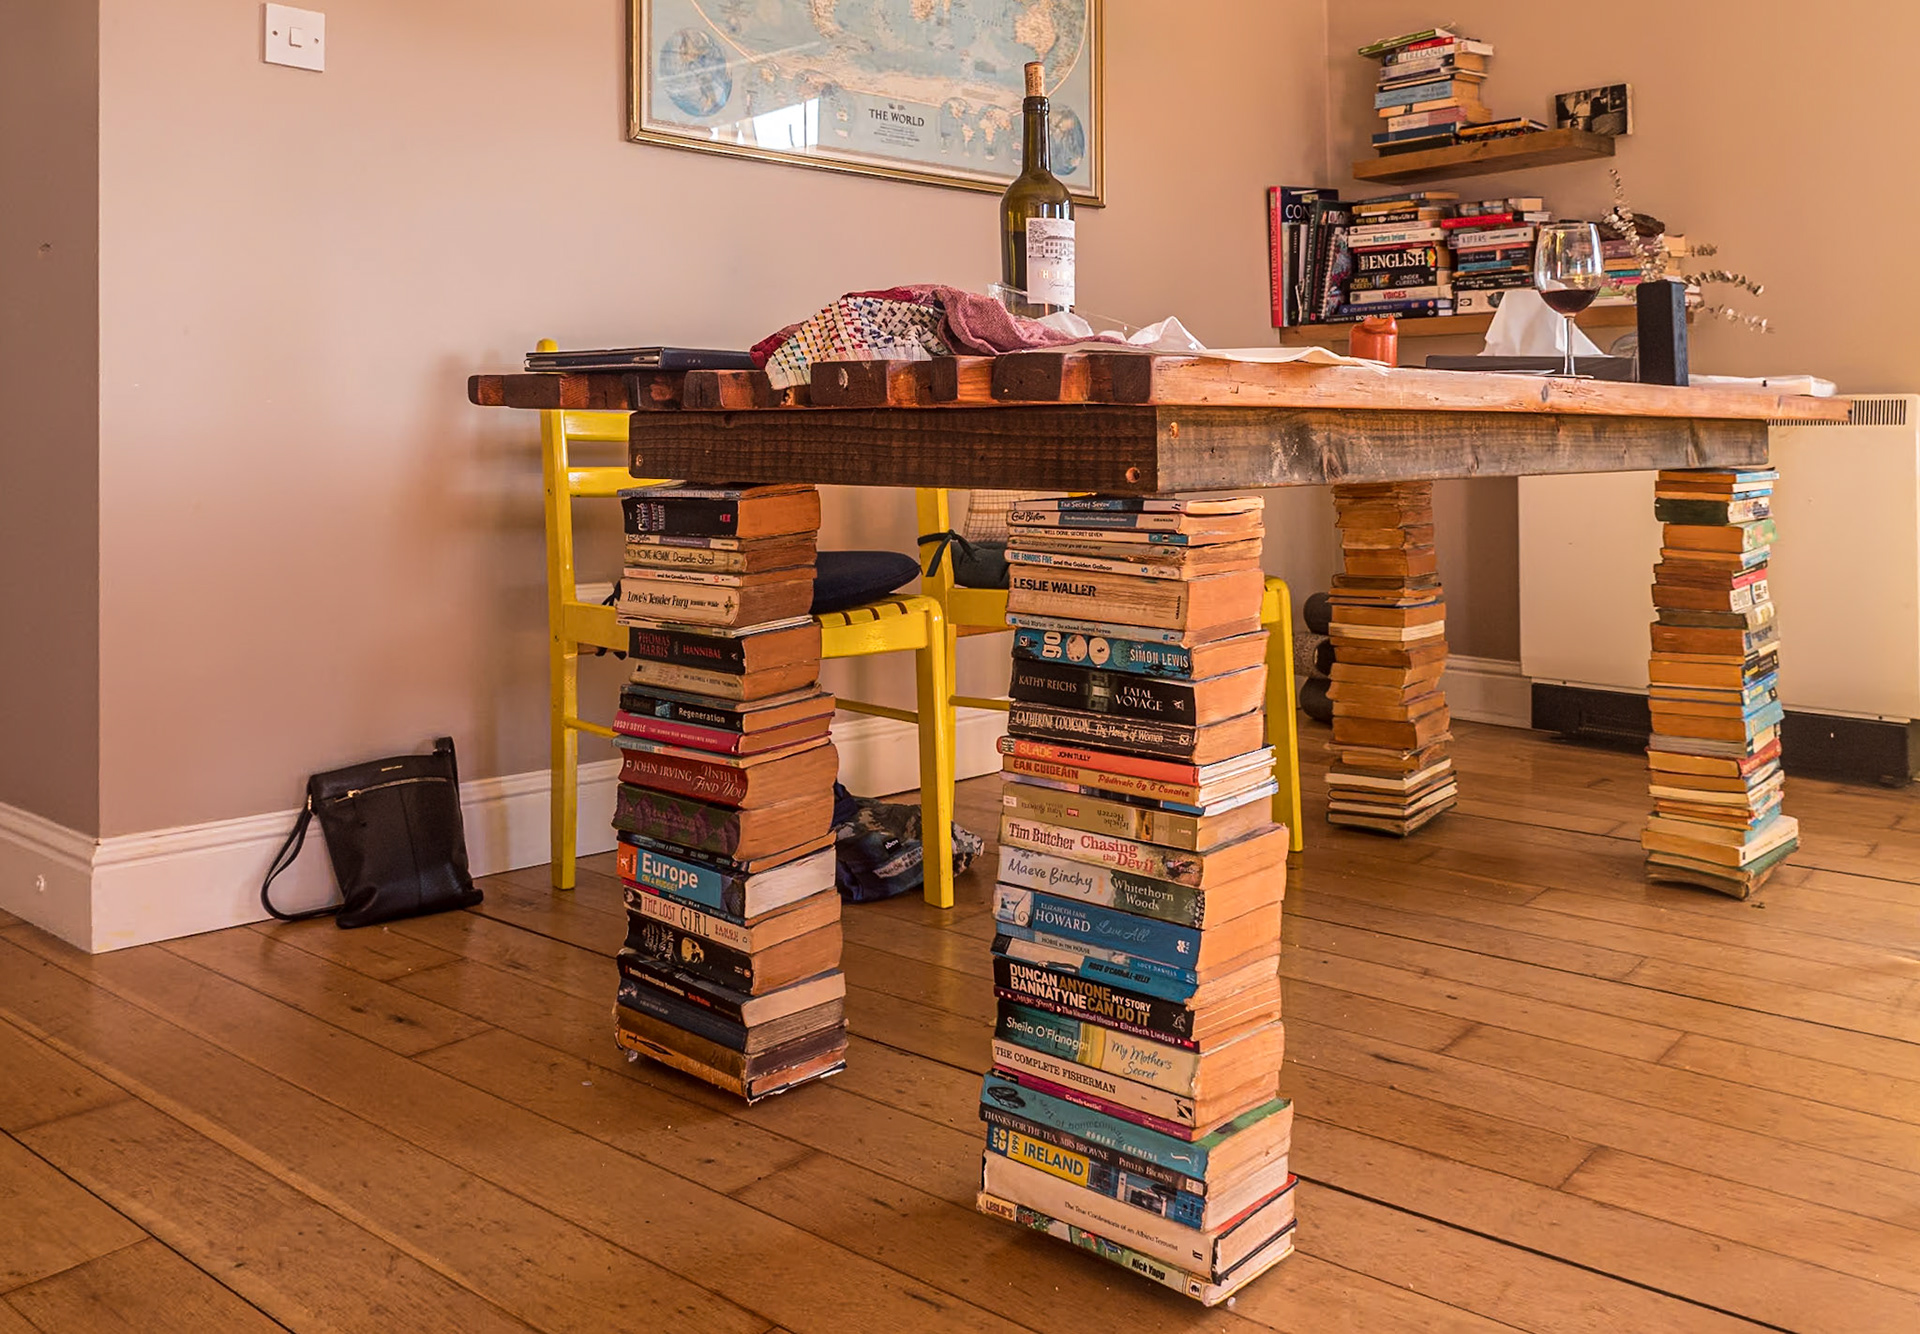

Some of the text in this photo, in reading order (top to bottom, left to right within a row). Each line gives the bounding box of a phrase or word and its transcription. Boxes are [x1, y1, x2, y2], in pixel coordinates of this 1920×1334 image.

[1405, 47, 1445, 59] IRELAND
[868, 108, 925, 127] THE WORLD
[1369, 251, 1425, 269] ENGLISH
[1383, 290, 1407, 299] VOICES
[1071, 502, 1091, 510] Secret
[698, 552, 714, 565] Steel
[1010, 552, 1020, 560] THE
[1021, 552, 1041, 563] FAMOUS
[1042, 554, 1053, 564] FIVE
[1073, 561, 1091, 569] Golden
[1014, 578, 1097, 597] LESLIE WALLER
[628, 591, 689, 609] Love's Tender Fury
[638, 632, 670, 646] THOMAS
[640, 643, 669, 658] HARRIS
[682, 644, 722, 659] HANNIBAL
[1130, 648, 1159, 665] SIMON
[1162, 652, 1189, 668] LEWIS
[1018, 675, 1078, 694] KATHY REICHS
[1123, 686, 1154, 699] FATAL
[1115, 694, 1163, 712] VOYAGE
[679, 708, 725, 723] Regeneration
[1016, 711, 1053, 729] CATHERINE
[1055, 716, 1090, 734] COOKSON
[1096, 724, 1107, 737] The
[1129, 730, 1138, 743] of
[1138, 730, 1164, 743] Women
[1020, 744, 1053, 759] SLADE
[1074, 753, 1092, 762] TULLY
[632, 760, 692, 781] JOHN IRVING
[1009, 822, 1075, 851] Tim Butcher
[1080, 835, 1139, 858] Chasing
[642, 853, 699, 889] Europe
[1102, 852, 1154, 874] the Devil
[1008, 858, 1093, 895] Maeve Binchy
[1113, 877, 1174, 901] Whitethorn
[1041, 903, 1087, 919] ELIZABETH JANE
[1126, 893, 1160, 911] Woods
[644, 897, 657, 915] THE
[660, 900, 676, 922] LOST
[680, 907, 710, 937] GIRL
[1035, 909, 1091, 933] HOWARD
[1124, 930, 1151, 943] All
[1137, 961, 1151, 969] LUCY
[1153, 965, 1177, 976] DANIELS
[1010, 964, 1152, 1013] DUNCAN ANYONE MY STORY
[1010, 978, 1151, 1027] BANNATYNE CAN DO IT
[1007, 1016, 1090, 1052] Sheila O'Flanagan
[1062, 1006, 1072, 1015] The
[1120, 1022, 1150, 1037] Elizabeth
[1151, 1030, 1175, 1044] Lindsay
[1111, 1041, 1173, 1070] My Mother's
[995, 1046, 1013, 1060] THE
[1014, 1052, 1060, 1077] COMPLETE
[1062, 1068, 1116, 1094] FISHERMAN
[1123, 1061, 1158, 1080] Secret
[984, 1110, 1011, 1127] THANKS
[1012, 1120, 1026, 1131] FOR
[1026, 1124, 1041, 1136] THE
[1059, 1136, 1076, 1150] MRS
[1076, 1141, 1110, 1161] BROWNE
[1118, 1157, 1144, 1174] PHYLLIS
[1146, 1166, 1174, 1184] BROWNE
[998, 1129, 1007, 1151] GO
[1086, 1131, 1117, 1147] ROBERT
[1012, 1135, 1084, 1176] 1999 IRELAND
[986, 1200, 1013, 1219] LESLIE'S
[1065, 1201, 1074, 1210] The
[1075, 1205, 1086, 1215] True
[1088, 1211, 1120, 1229] Confessions
[1136, 1229, 1155, 1241] Albino
[1155, 1237, 1178, 1251] Terrorist
[1132, 1258, 1165, 1281] Nick Yapp
